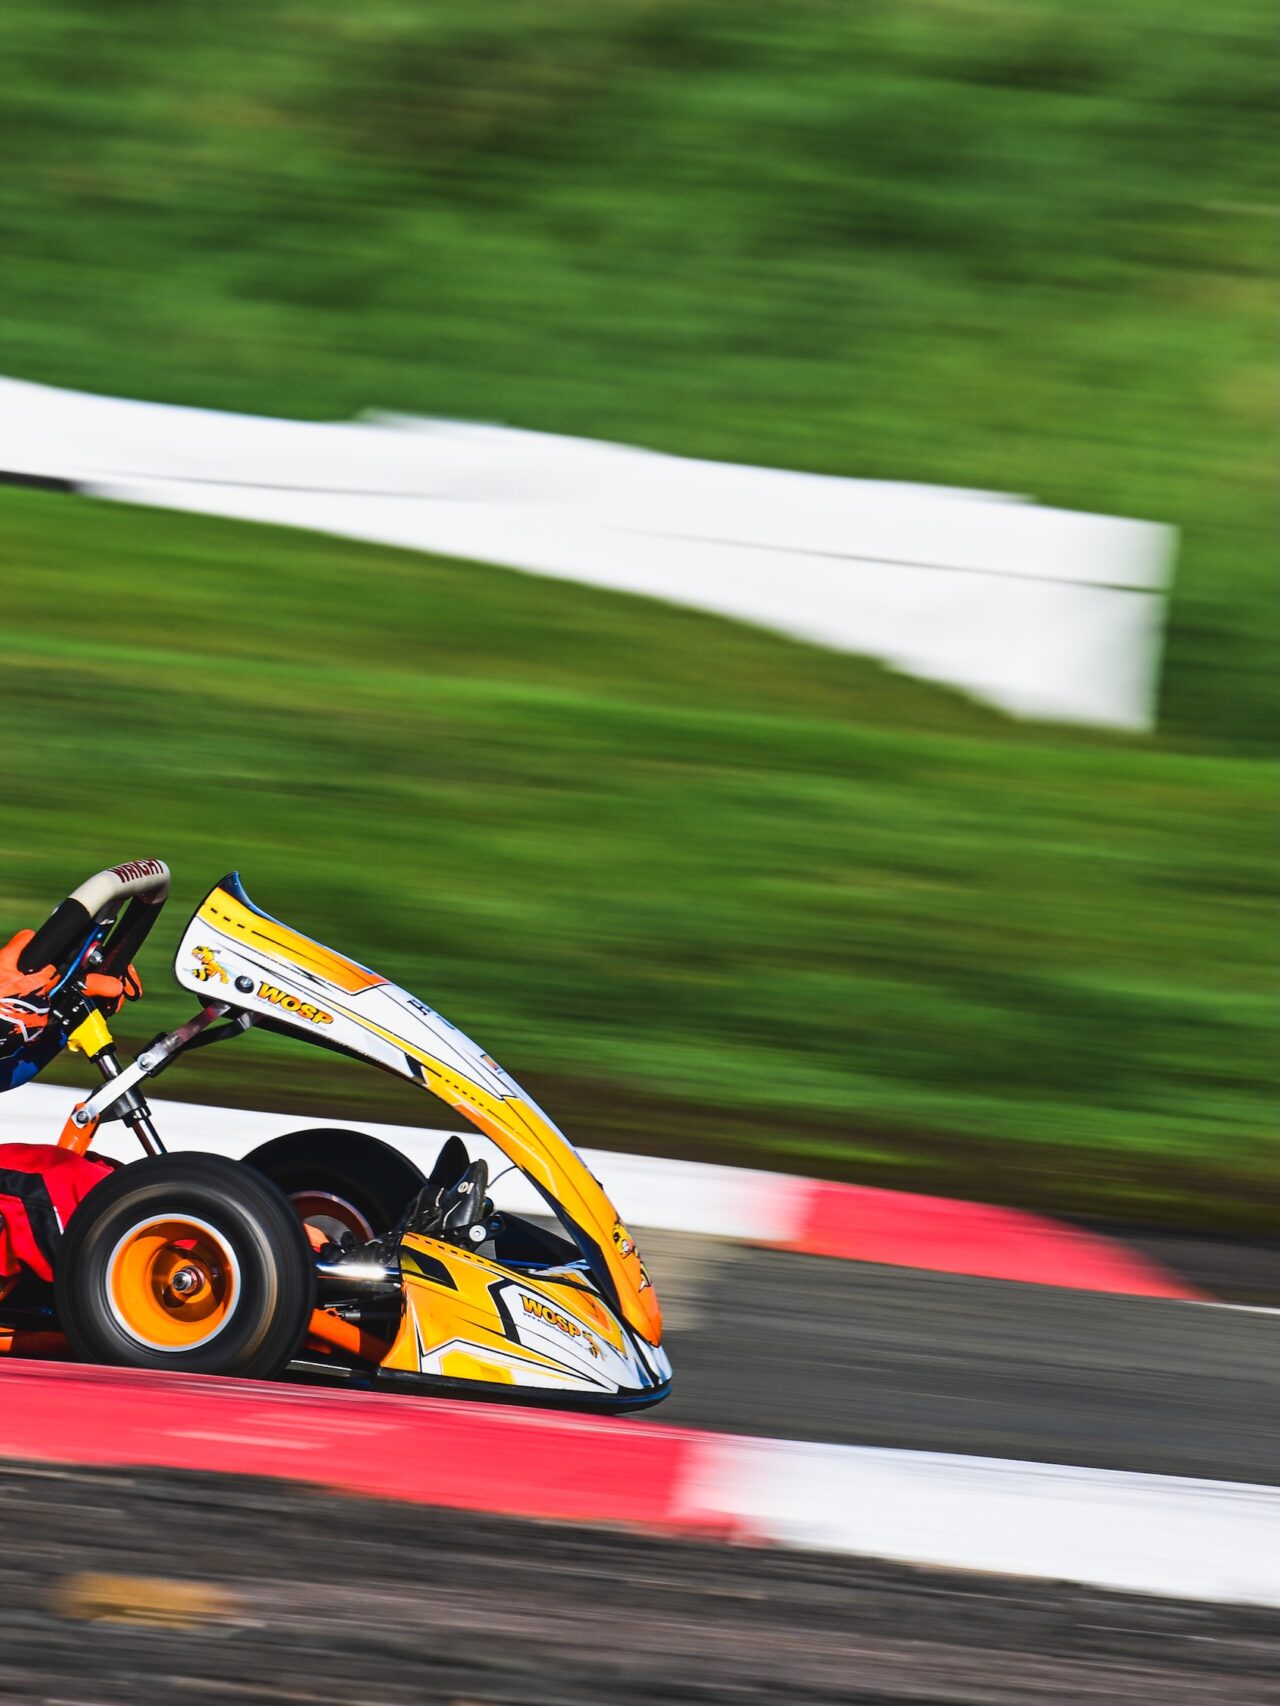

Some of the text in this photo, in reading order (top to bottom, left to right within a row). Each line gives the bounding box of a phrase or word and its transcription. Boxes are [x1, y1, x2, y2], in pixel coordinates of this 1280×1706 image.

[107, 859, 164, 883] WRIGHT
[257, 981, 334, 1024] WOSP
[518, 1293, 581, 1338] WOSP
